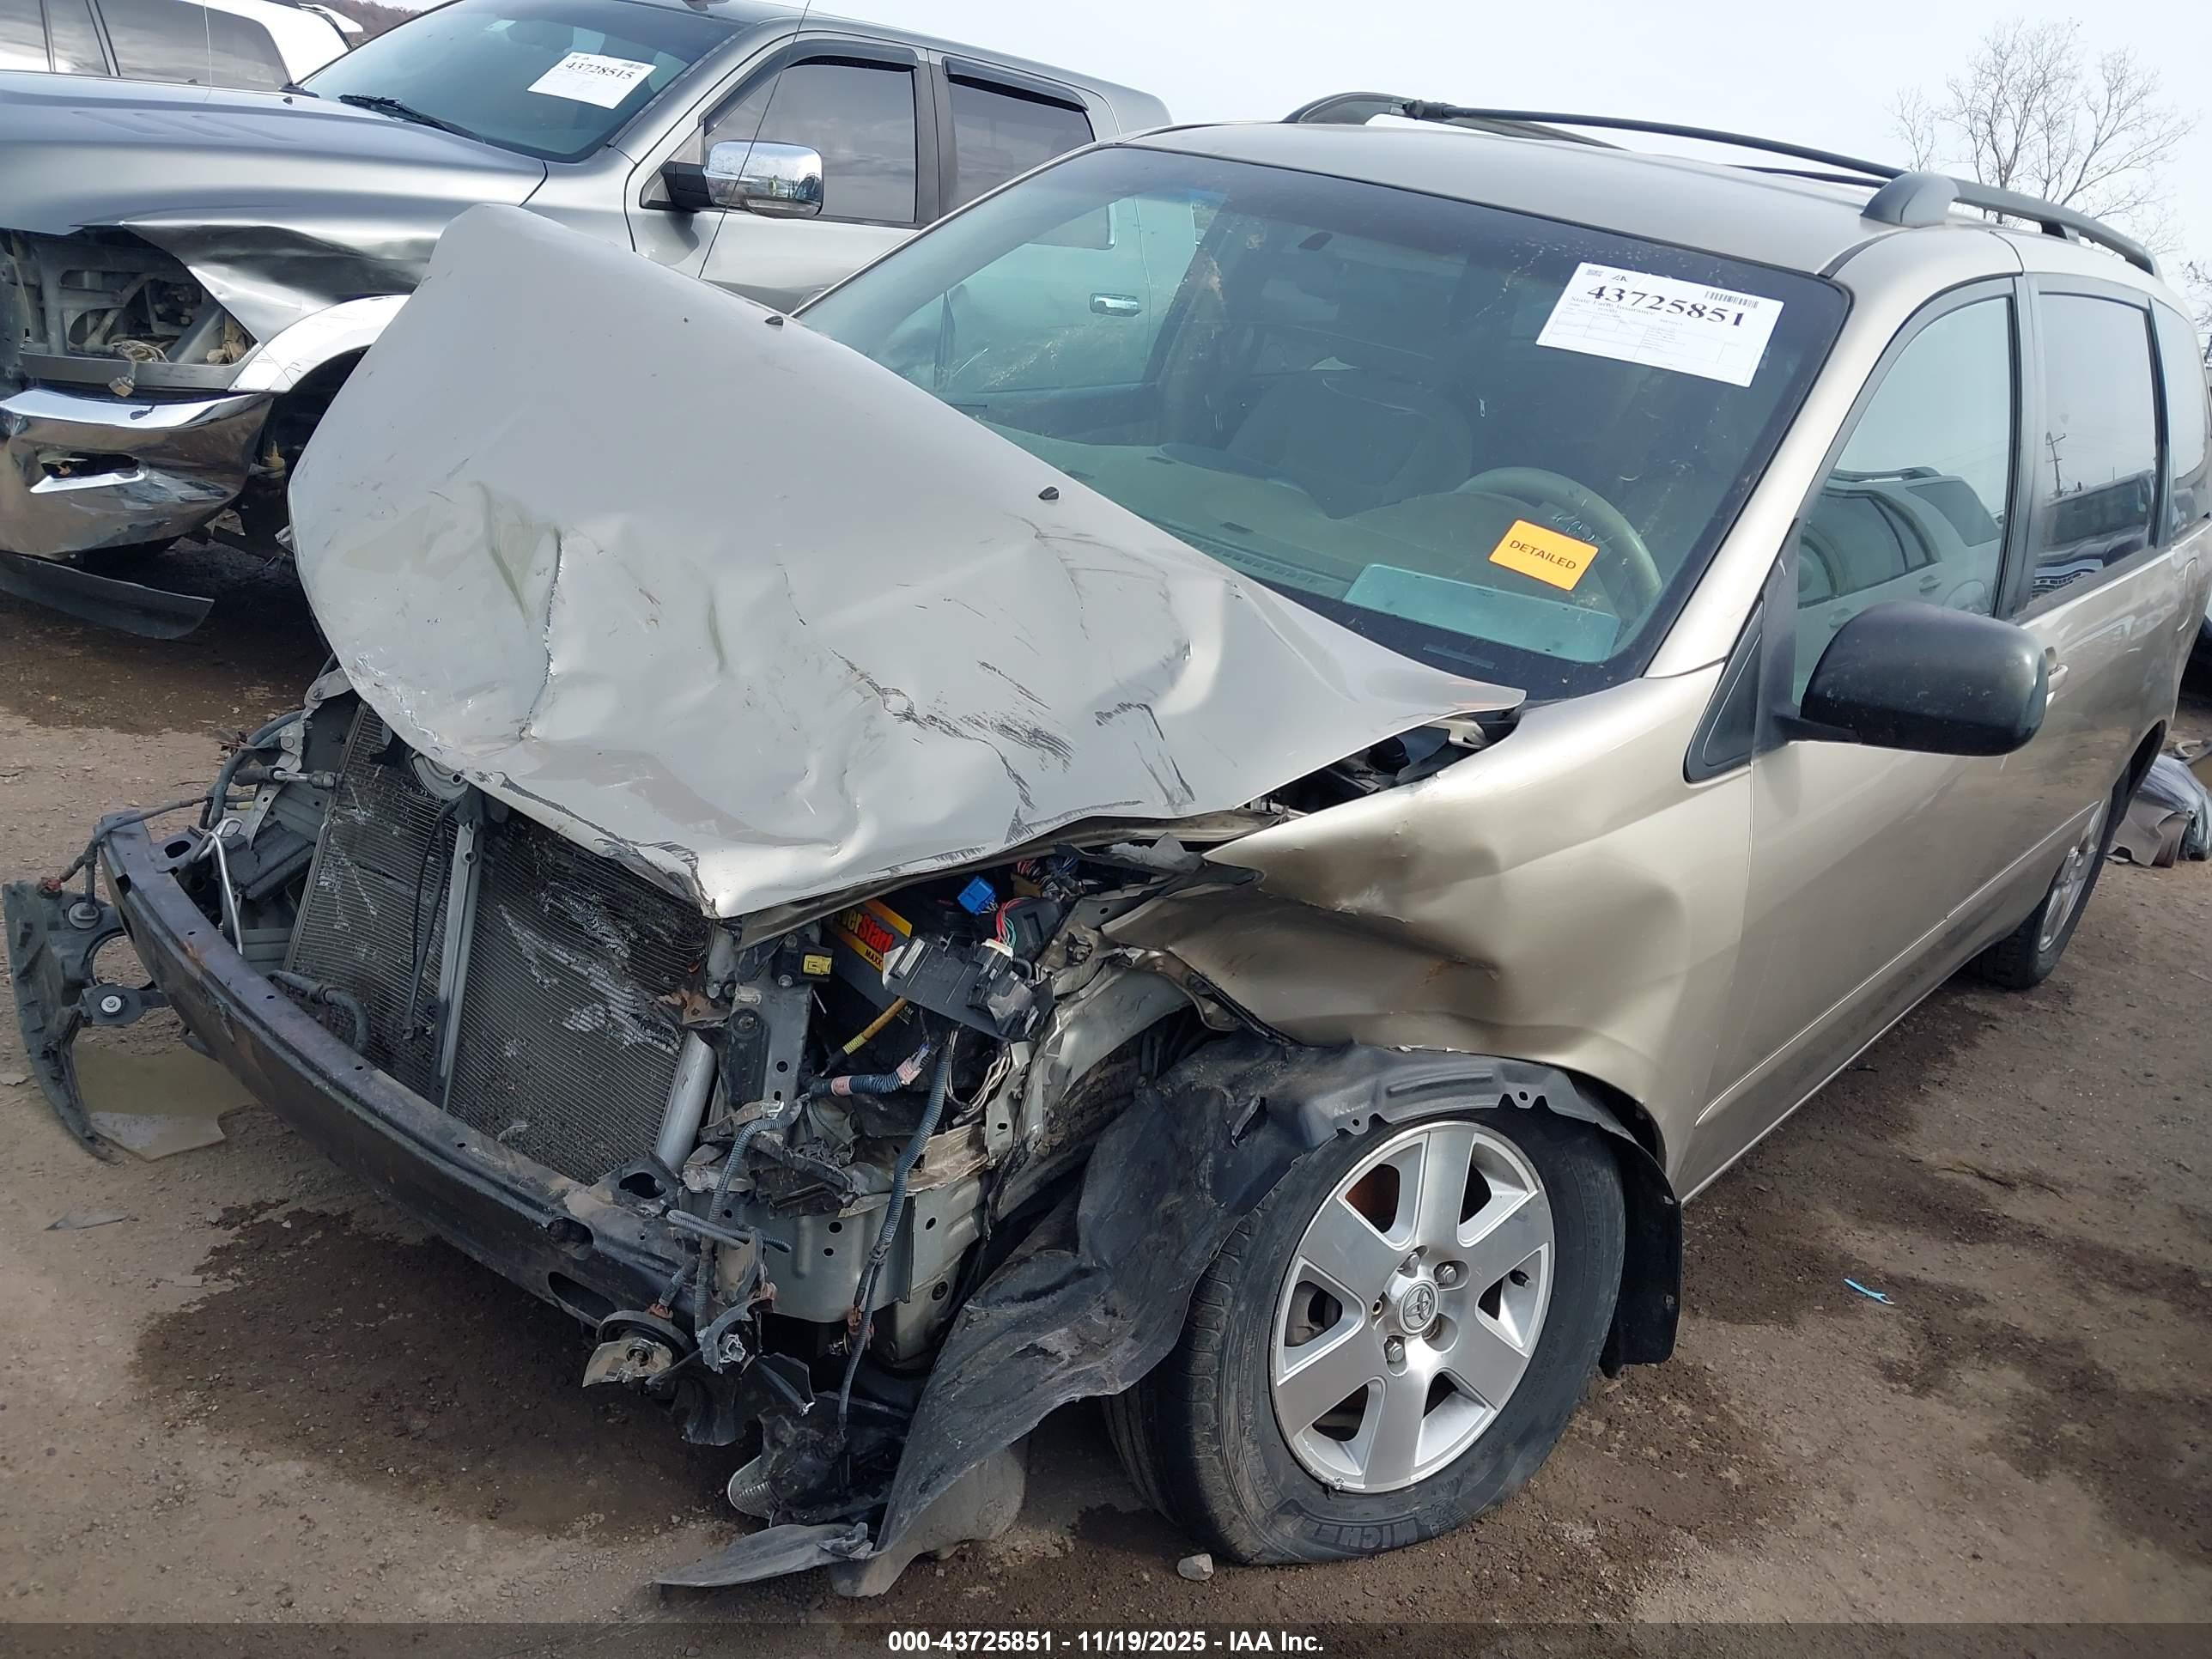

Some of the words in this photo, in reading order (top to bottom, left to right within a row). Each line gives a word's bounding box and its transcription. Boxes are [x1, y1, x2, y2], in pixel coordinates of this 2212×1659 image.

[565, 61, 636, 80] 43728515
[1587, 285, 1744, 327] 43725851
[1510, 539, 1577, 570] DETAILED
[866, 949, 883, 965] MAXX
[1279, 1515, 1419, 1552] MICHELI
